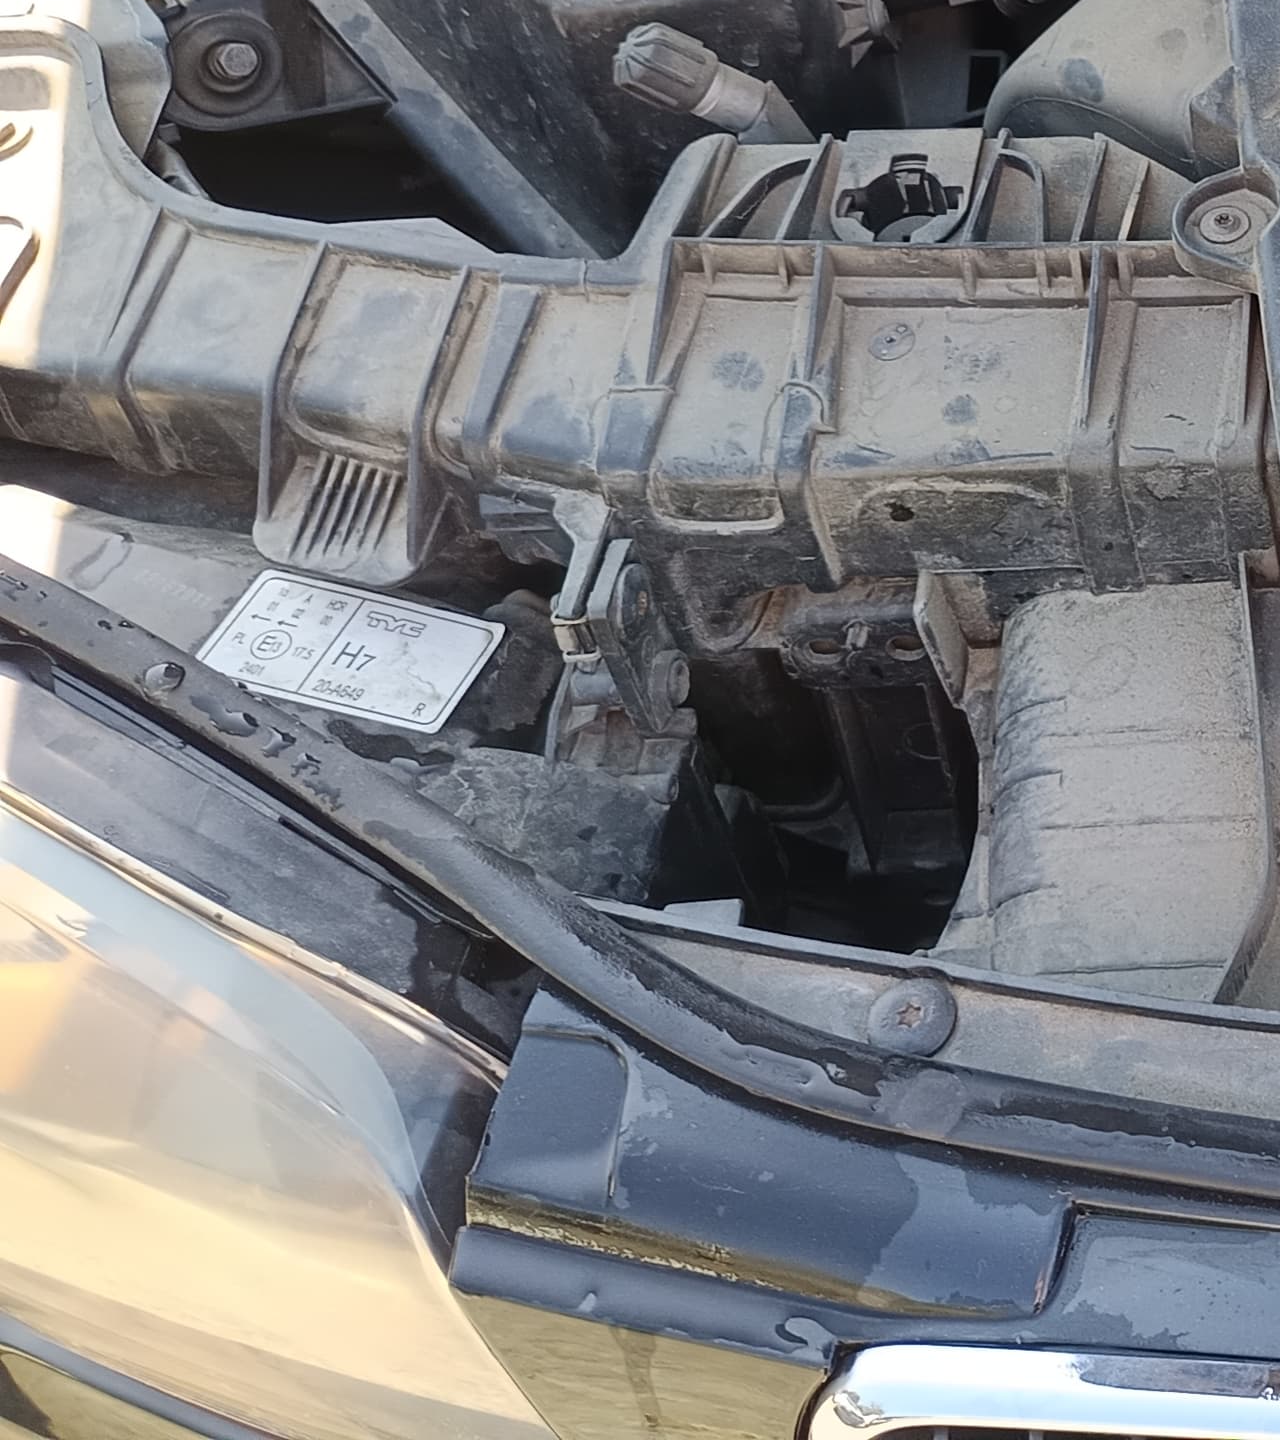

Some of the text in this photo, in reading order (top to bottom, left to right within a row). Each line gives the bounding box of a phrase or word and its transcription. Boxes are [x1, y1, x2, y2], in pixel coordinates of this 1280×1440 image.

[366, 610, 427, 638] TYC
[331, 641, 377, 671] H7
[411, 702, 427, 717] R
